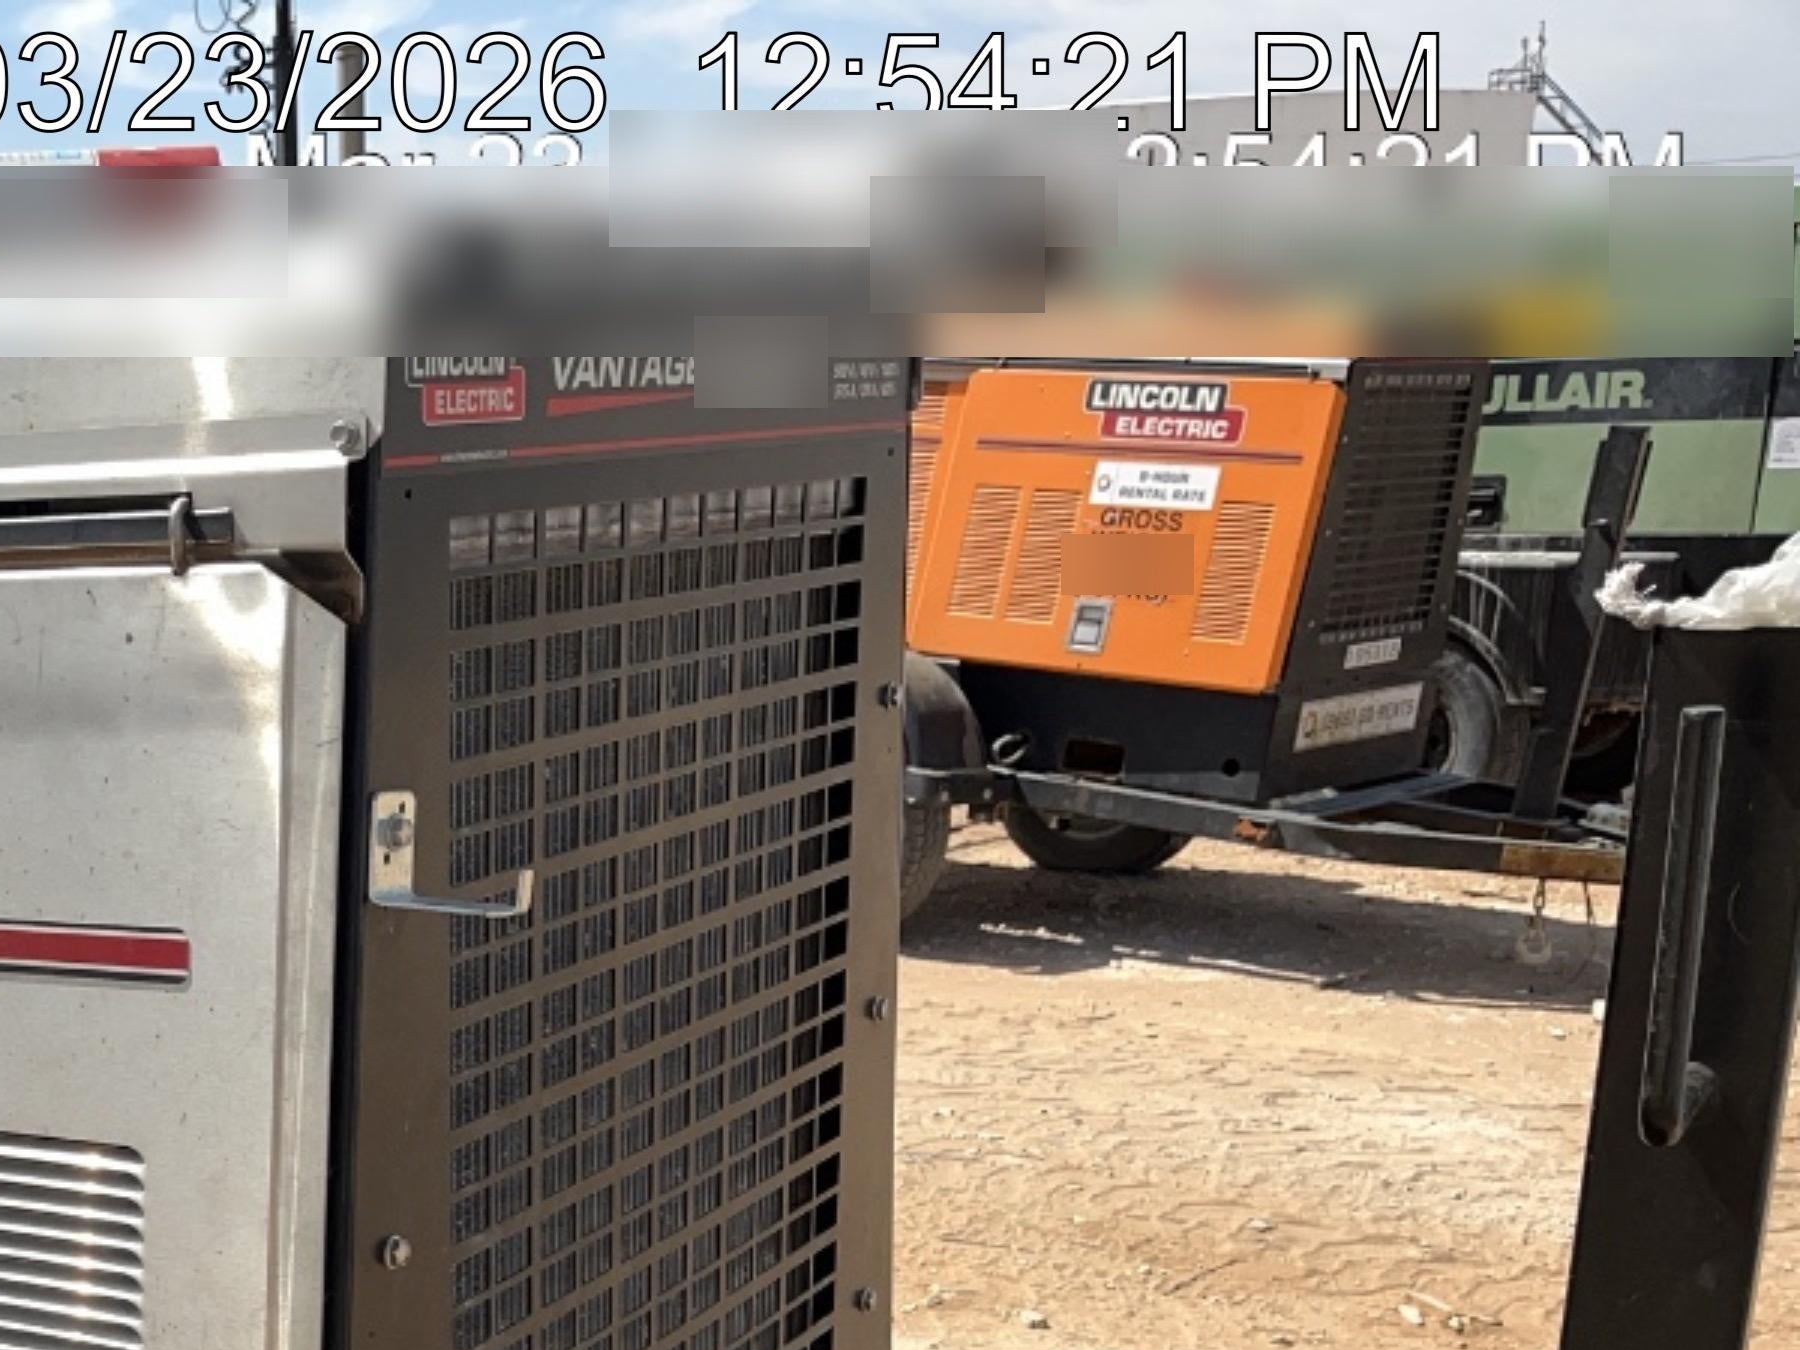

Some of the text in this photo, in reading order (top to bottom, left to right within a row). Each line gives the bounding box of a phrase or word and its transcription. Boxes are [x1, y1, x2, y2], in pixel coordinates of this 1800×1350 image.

[434, 386, 515, 415] ELECTRIC
[1091, 383, 1222, 412] LINCOLN
[1115, 416, 1229, 439] ELECTRIC
[1100, 507, 1184, 532] GROSS
